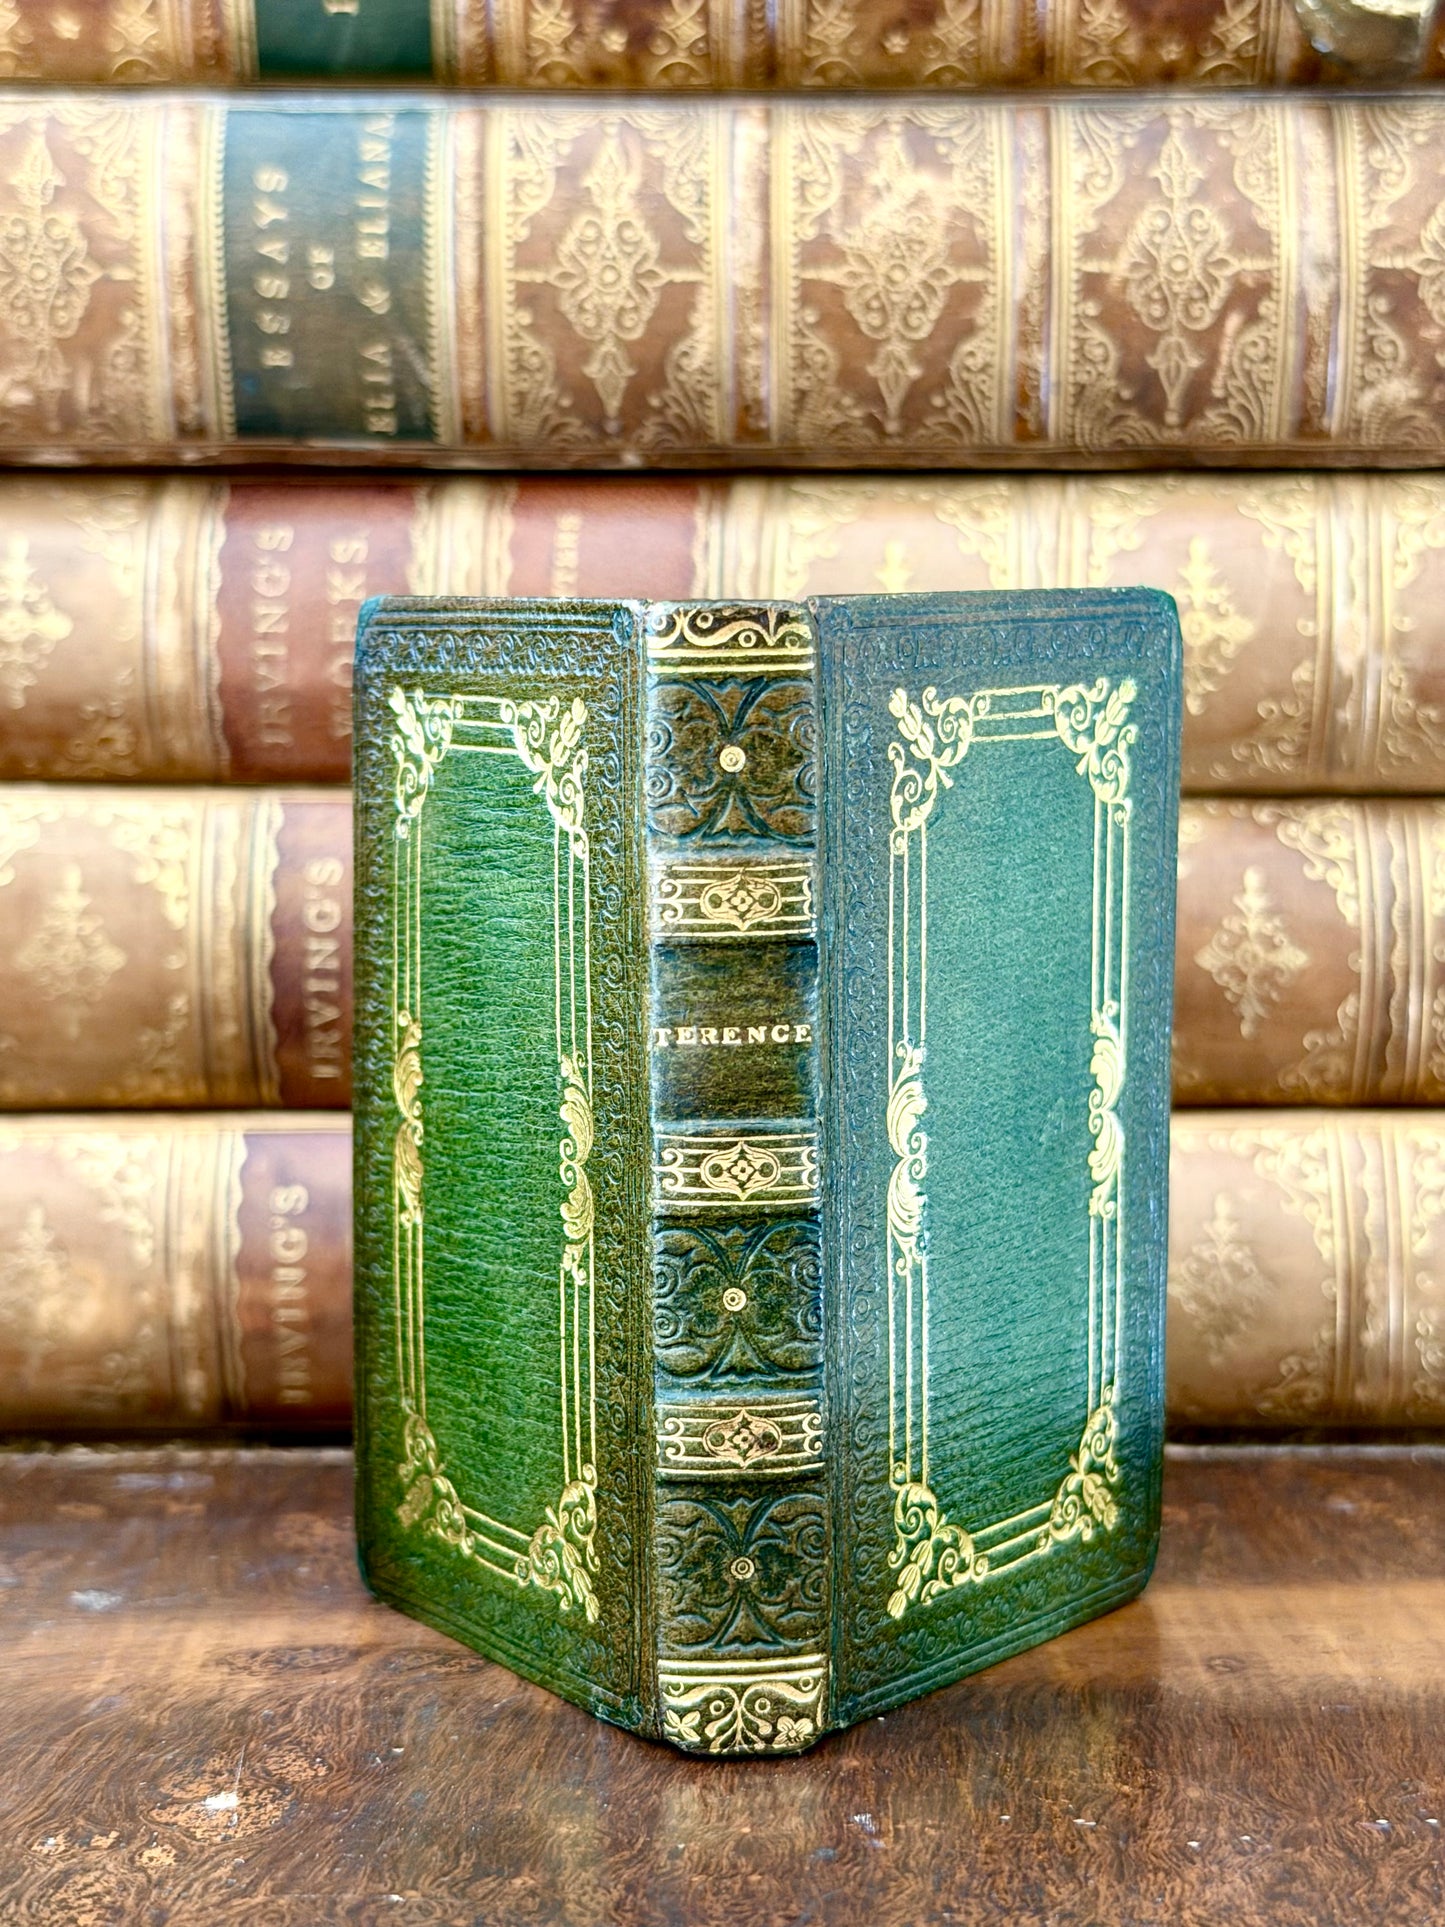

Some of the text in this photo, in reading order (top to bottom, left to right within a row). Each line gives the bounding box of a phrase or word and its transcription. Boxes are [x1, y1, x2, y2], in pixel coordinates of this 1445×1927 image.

[253, 163, 293, 367] ESSAYS
[306, 245, 335, 290] OF
[359, 341, 396, 435] ELIA
[252, 524, 294, 748] IRVING'S
[302, 857, 344, 1079] IRVING'S
[652, 1024, 813, 1047] TERENCE
[268, 1184, 310, 1405] IRVING'S
